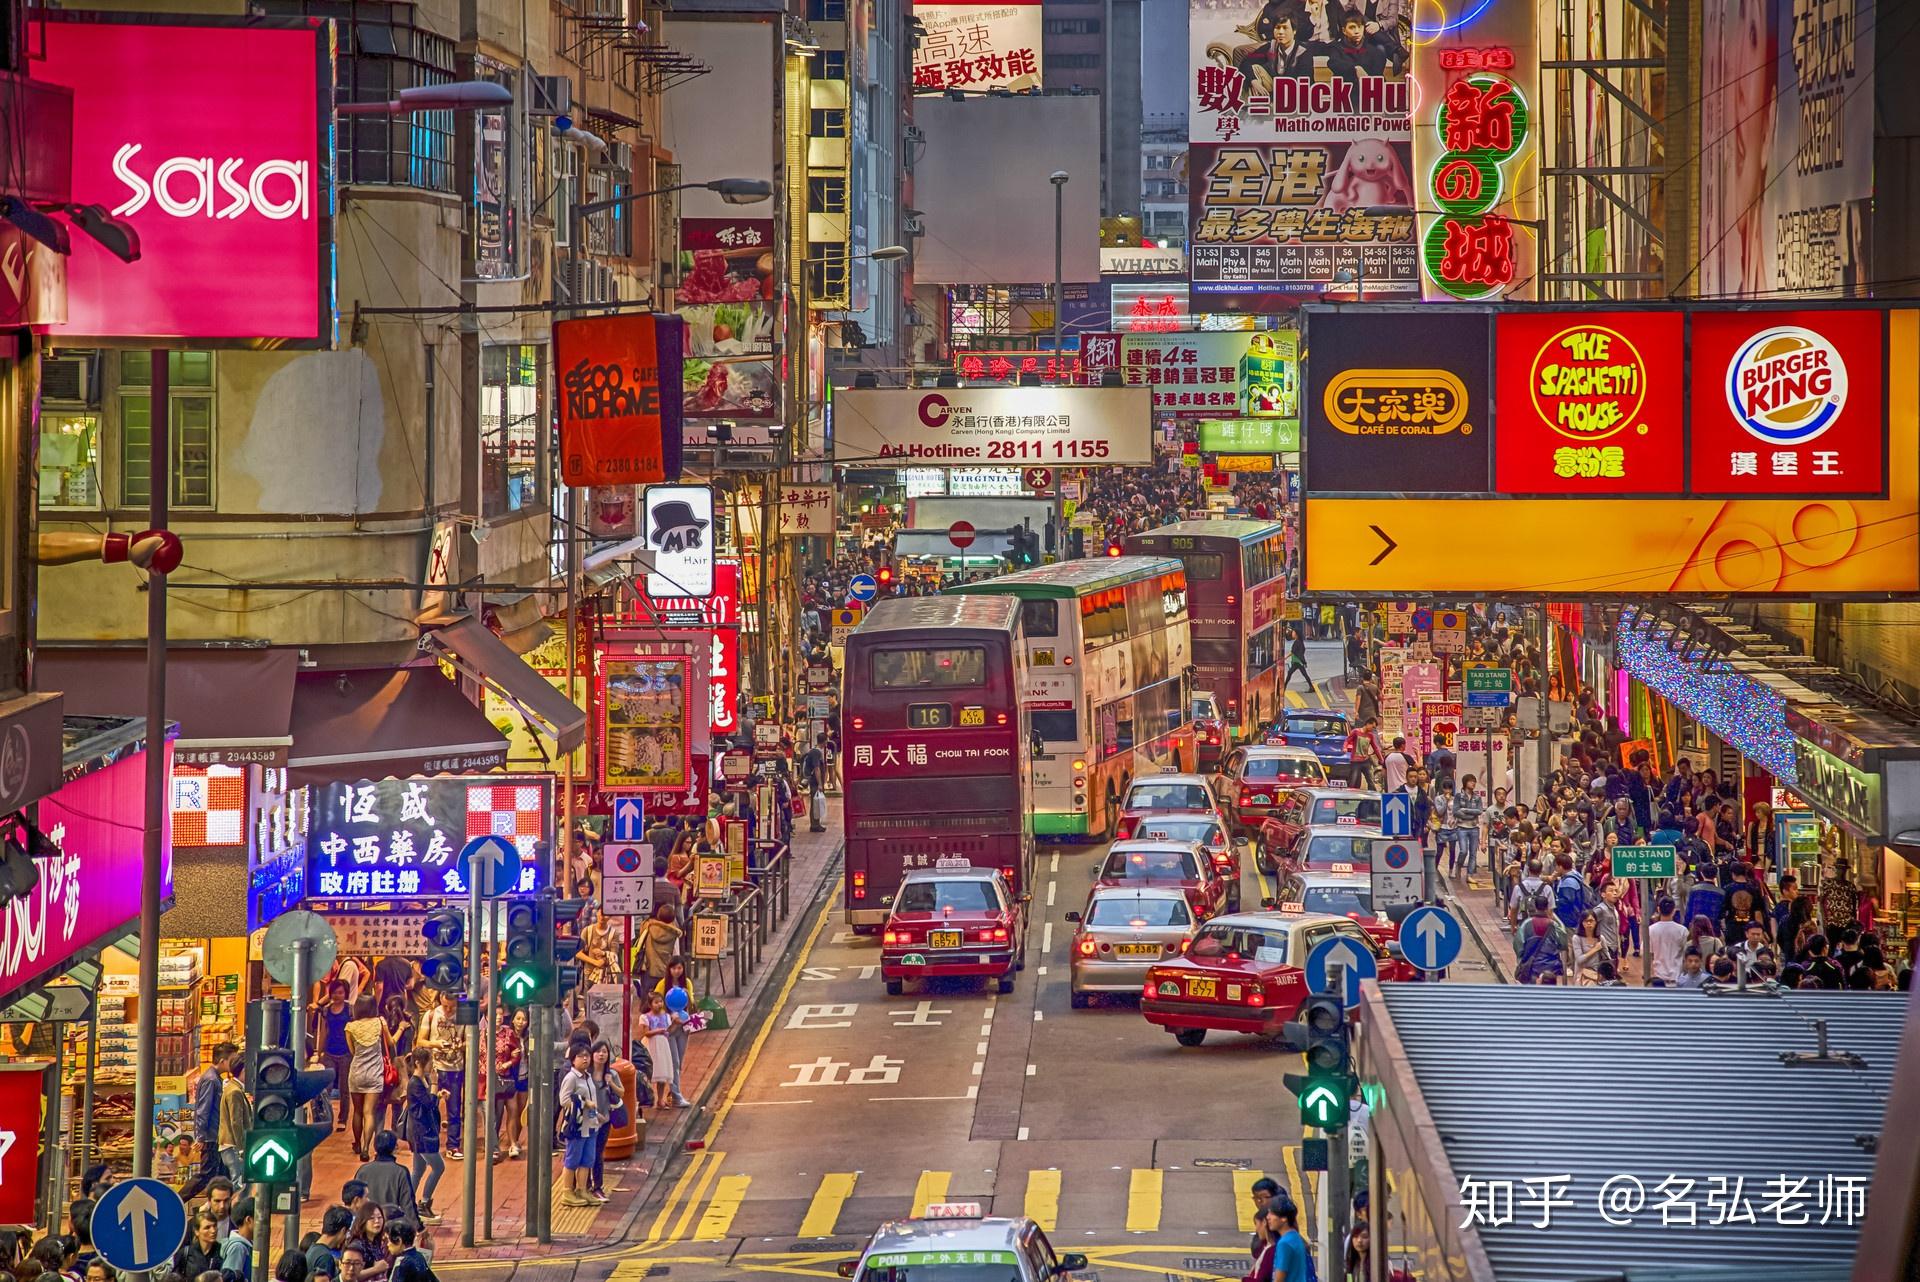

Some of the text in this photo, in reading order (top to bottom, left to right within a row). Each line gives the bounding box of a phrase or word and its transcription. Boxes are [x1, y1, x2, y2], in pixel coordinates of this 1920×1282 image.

[913, 48, 1037, 90] 極致效能
[1274, 77, 1353, 114] Dick
[1374, 116, 1411, 133] Powe
[1205, 147, 1328, 206] 全港
[1109, 257, 1178, 272] WHAT'S
[1196, 258, 1218, 267] Math
[1279, 258, 1302, 267] Math
[1308, 258, 1330, 267] Math
[1364, 258, 1387, 267] Math
[1392, 258, 1415, 267] Math
[1281, 267, 1302, 275] Core
[1309, 267, 1330, 275] Core
[1560, 332, 1611, 361] THE
[1126, 346, 1197, 367] 連續4年
[1743, 349, 1829, 391] BURGER
[1747, 368, 1832, 419] KING
[952, 414, 1071, 428] 永昌行(香港)有限公司
[1558, 400, 1624, 432] HOUSE
[1360, 422, 1433, 436] CAFÉ DE CORAL
[879, 440, 1110, 459] Ad Hotline: 2811 1155
[1552, 446, 1626, 478] 意粉屋
[1730, 450, 1841, 476] 漢堡王
[953, 475, 1008, 483] VIRGINIA
[663, 528, 700, 553] MR
[1171, 537, 1194, 550] 905
[1453, 644, 1464, 652] 12
[1474, 679, 1503, 688] 的士站
[920, 708, 940, 725] 16
[853, 744, 1009, 767] 周大福 CHOW TAI FOOK
[320, 831, 455, 868] 中西藥房
[1616, 850, 1671, 859] TAXI STAND
[1334, 864, 1352, 872] TAXI
[1625, 862, 1662, 873] 的士站
[635, 881, 644, 891] 7
[1403, 877, 1412, 888] 7
[635, 899, 650, 910] 12
[1282, 903, 1303, 911] TAXI
[701, 926, 716, 935] 12B
[801, 965, 881, 981] ST
[1192, 988, 1212, 997] 577
[783, 1001, 953, 1030] 巴士
[930, 1205, 977, 1217] TAXI
[878, 1255, 908, 1267] POAD
